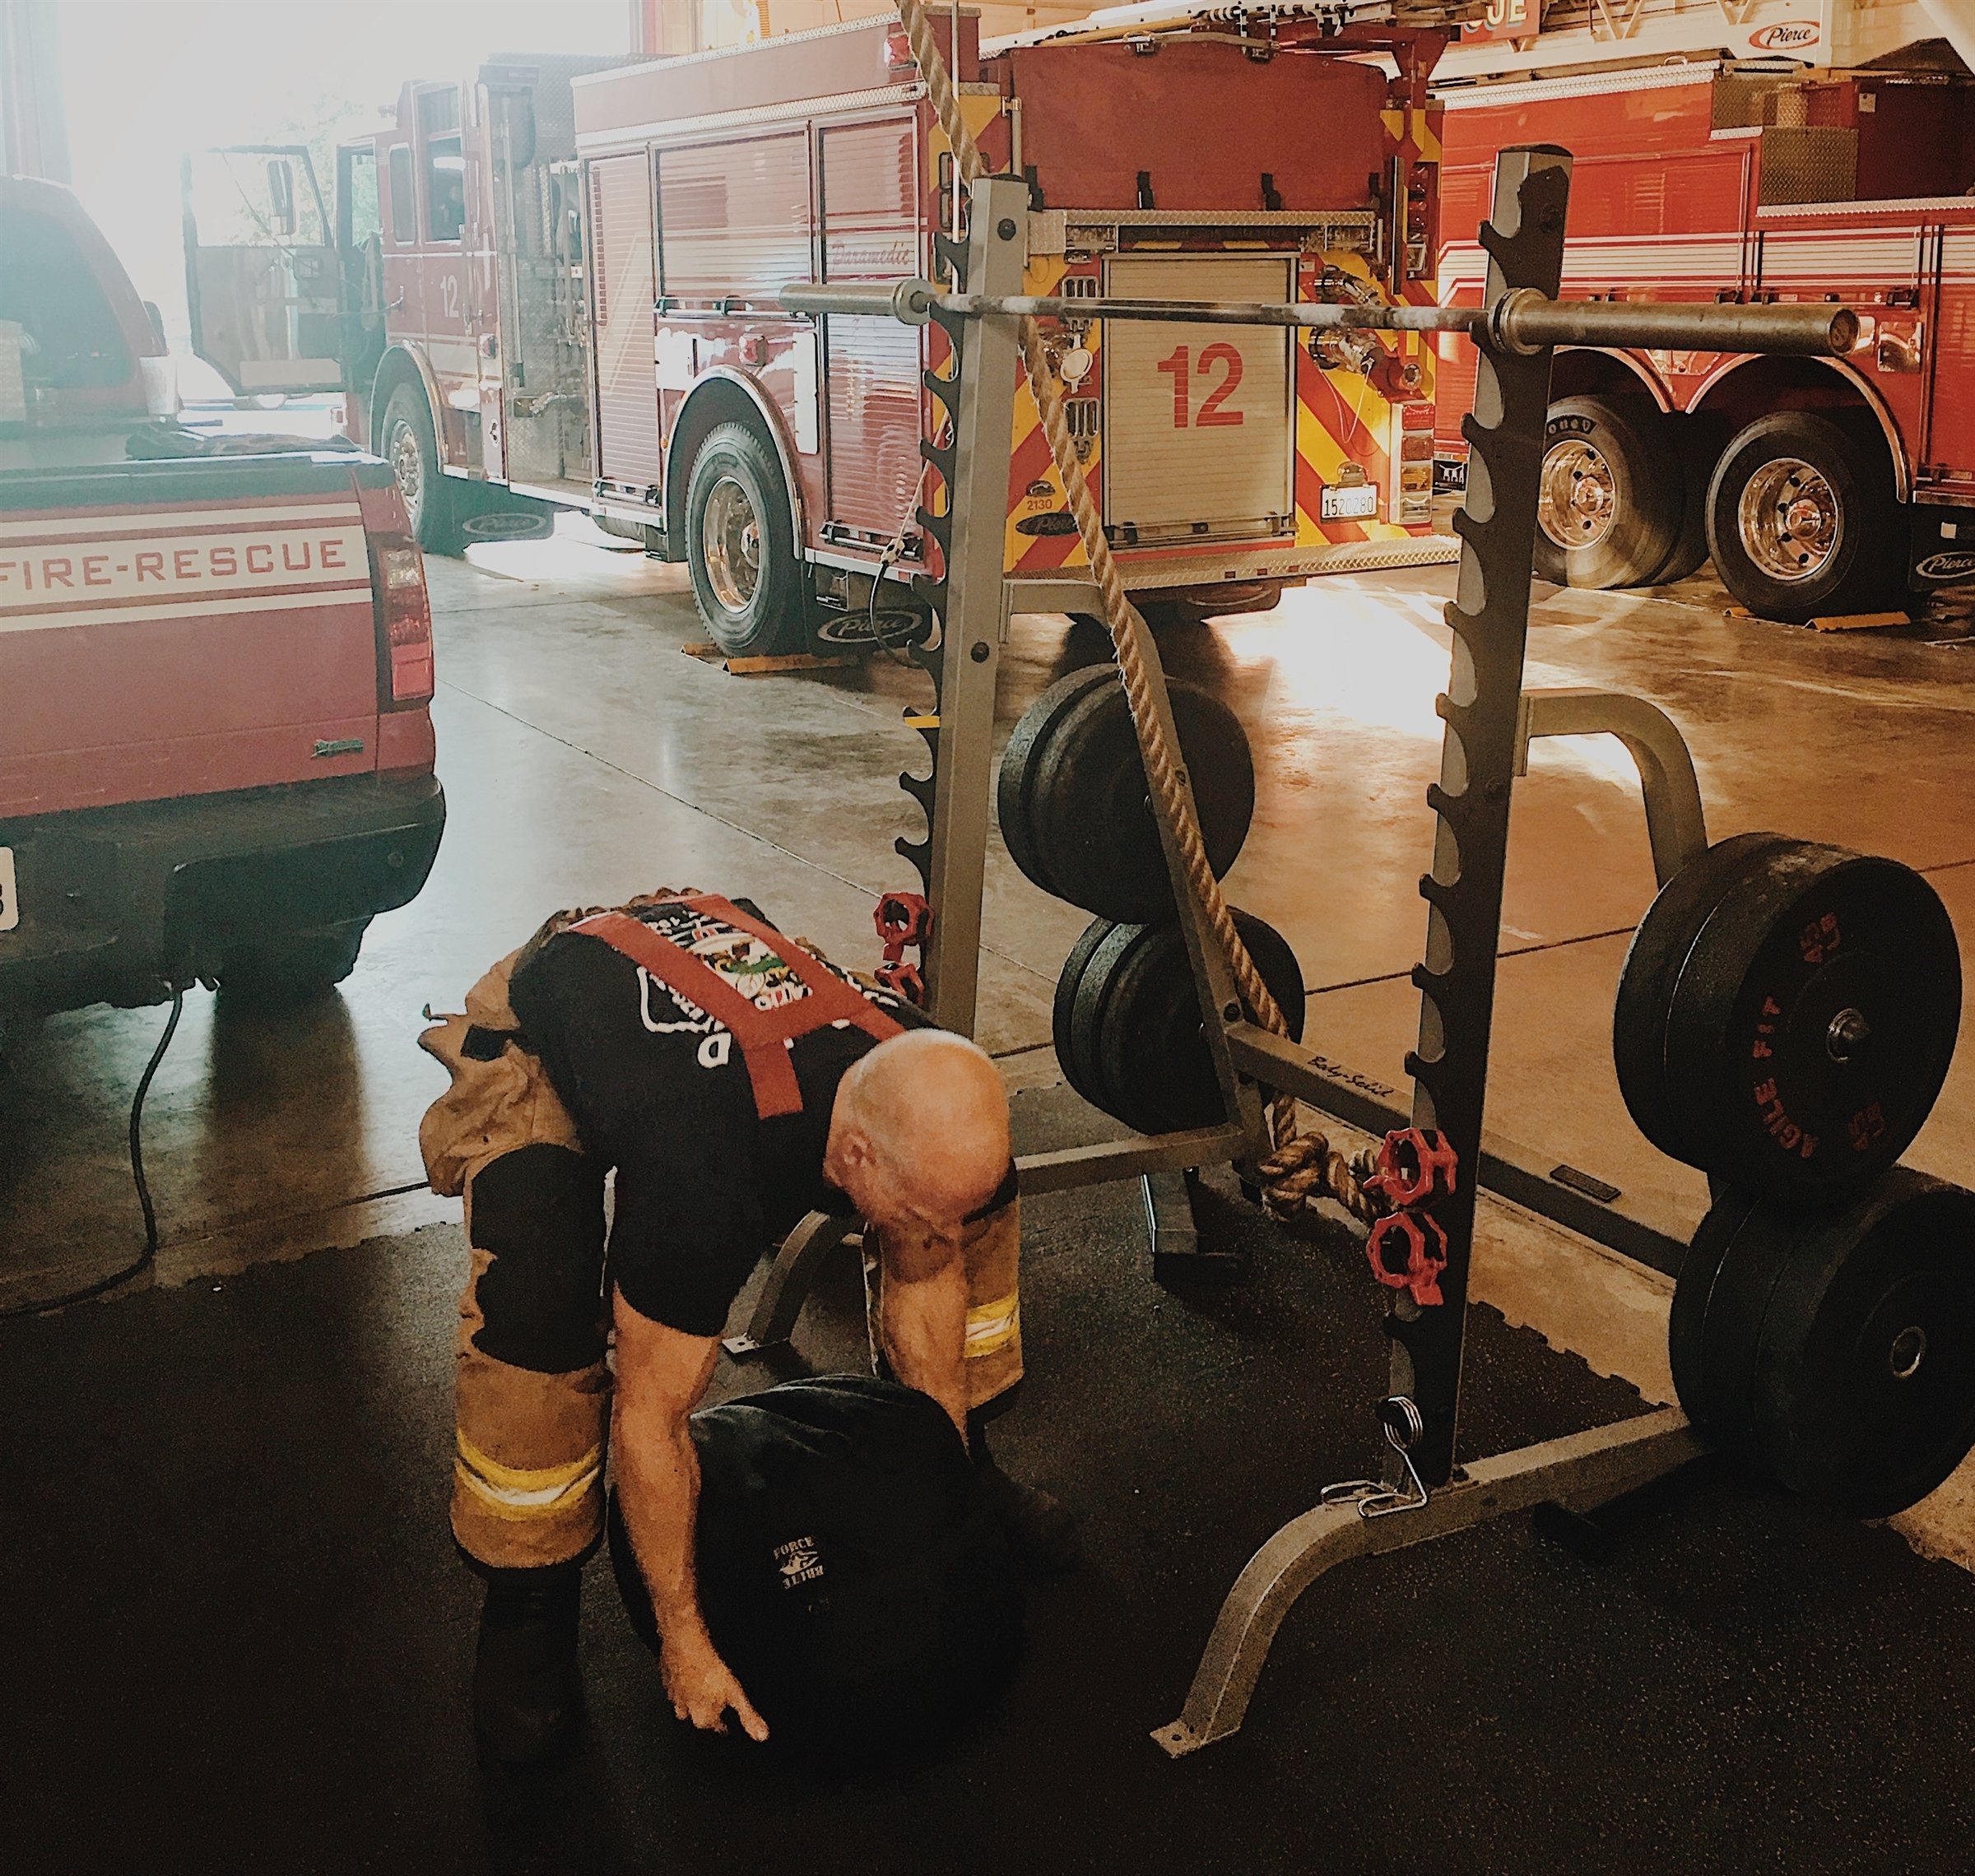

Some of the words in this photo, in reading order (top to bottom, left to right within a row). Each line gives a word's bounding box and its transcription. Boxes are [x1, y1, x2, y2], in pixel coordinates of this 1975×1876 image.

[1766, 26, 1811, 45] Pierce
[831, 239, 910, 272] Paramedic
[439, 274, 459, 318] 12
[1157, 341, 1243, 428] 12
[1026, 499, 1053, 510] 2130
[773, 1536, 815, 1560] FORCE
